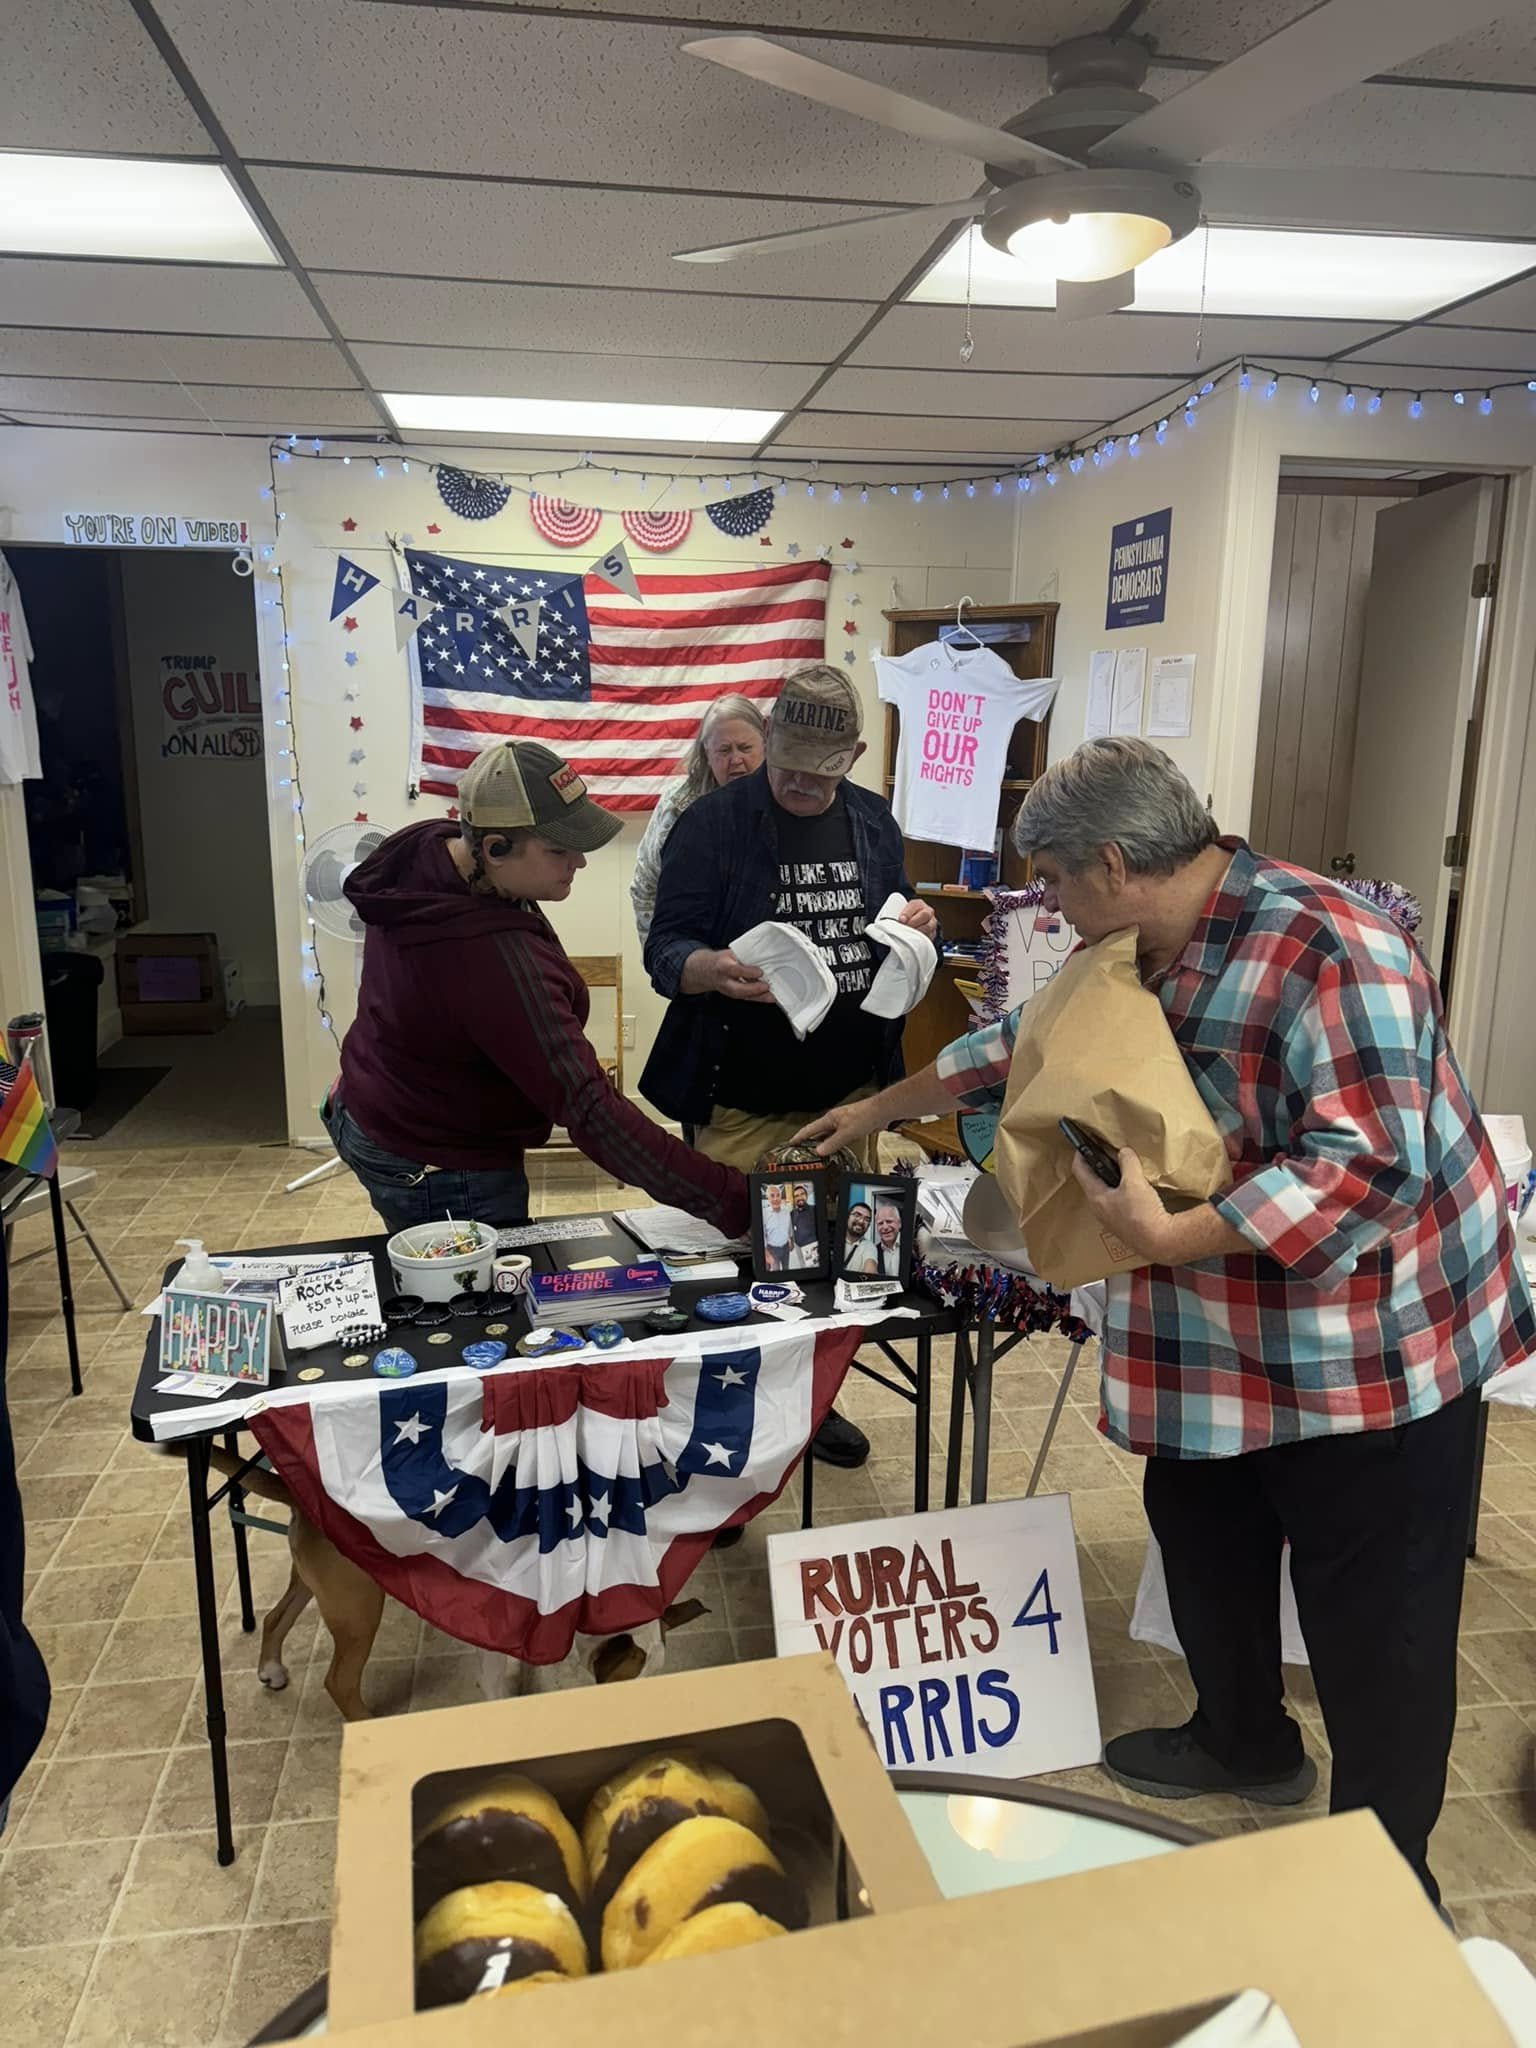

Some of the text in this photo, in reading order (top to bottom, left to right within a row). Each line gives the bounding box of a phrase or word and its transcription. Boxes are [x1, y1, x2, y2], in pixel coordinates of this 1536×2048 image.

[66, 515, 238, 544] YOU'RE ON VIDEO
[1113, 535, 1165, 571] PENNSYLVANIA
[1111, 565, 1163, 604] DEMOCRATS
[161, 655, 217, 671] TRUMP
[162, 671, 262, 721] GUIL
[928, 689, 986, 715] DON'T
[783, 700, 849, 732] MARINE
[926, 711, 983, 733] GIVE UP
[168, 731, 256, 756] ON ALL 34
[922, 729, 979, 768] OUR
[919, 762, 973, 787] RIGHTS
[793, 863, 828, 885] LIKE
[828, 861, 859, 883] TRU
[795, 888, 865, 914] PROBABL
[817, 917, 850, 940] LIKE
[296, 1278, 344, 1302] ROCKS
[541, 1271, 606, 1286] DEFEND
[553, 1278, 614, 1293] CHOICE
[168, 1297, 263, 1377] HAPPY
[800, 1538, 980, 1620] RURAL
[814, 1568, 1062, 1674] VOTERS 4
[854, 1669, 1021, 1765] RRIS
